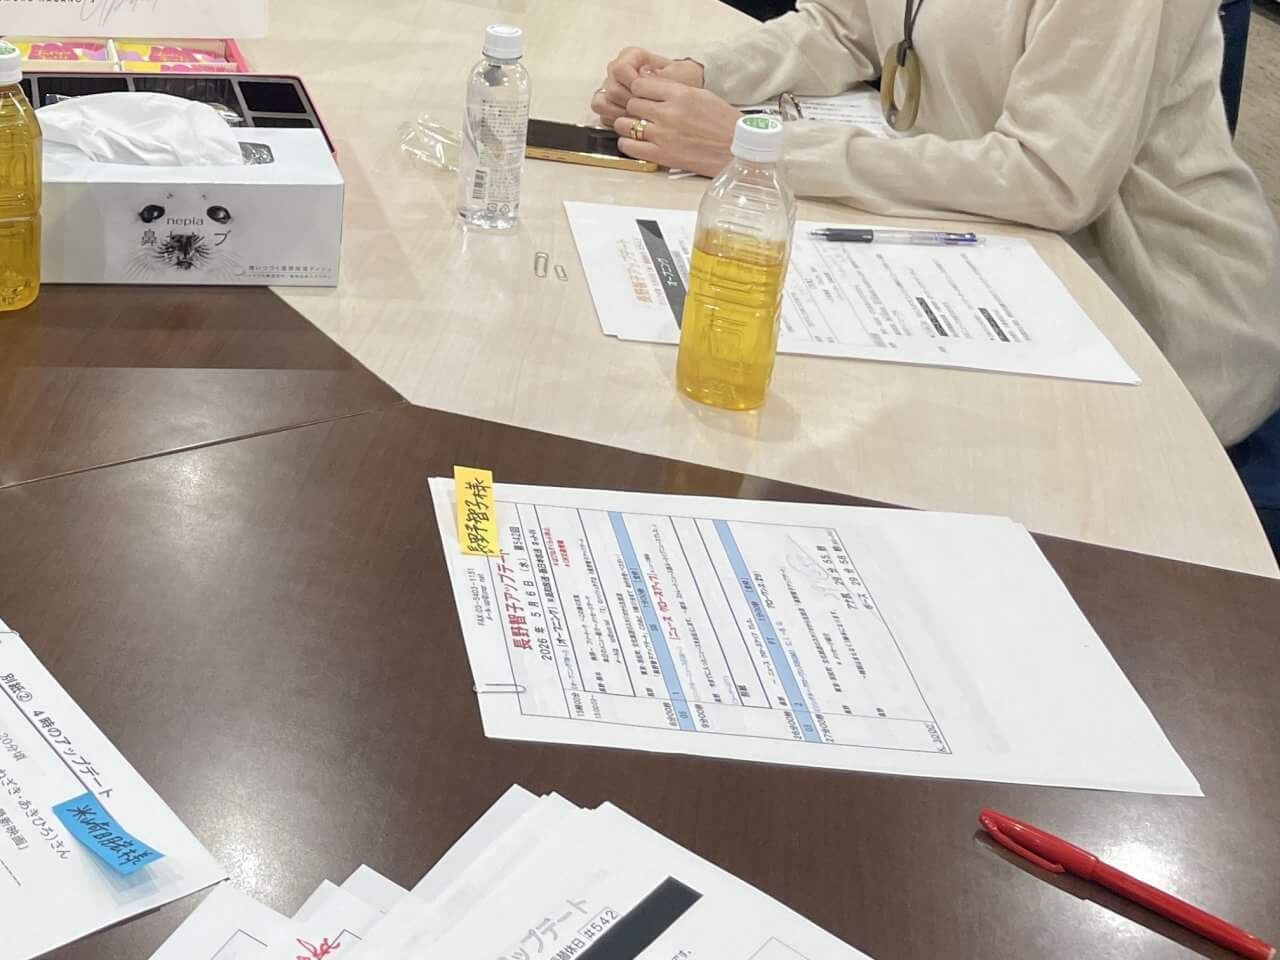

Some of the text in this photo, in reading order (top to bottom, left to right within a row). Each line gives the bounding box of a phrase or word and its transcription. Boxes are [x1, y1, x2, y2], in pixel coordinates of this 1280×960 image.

[167, 216, 204, 226] nepia
[536, 638, 553, 660] 2026
[30, 708, 118, 800] 4時のアップデート
[500, 899, 587, 960] ップデート
[582, 907, 619, 940] #542
